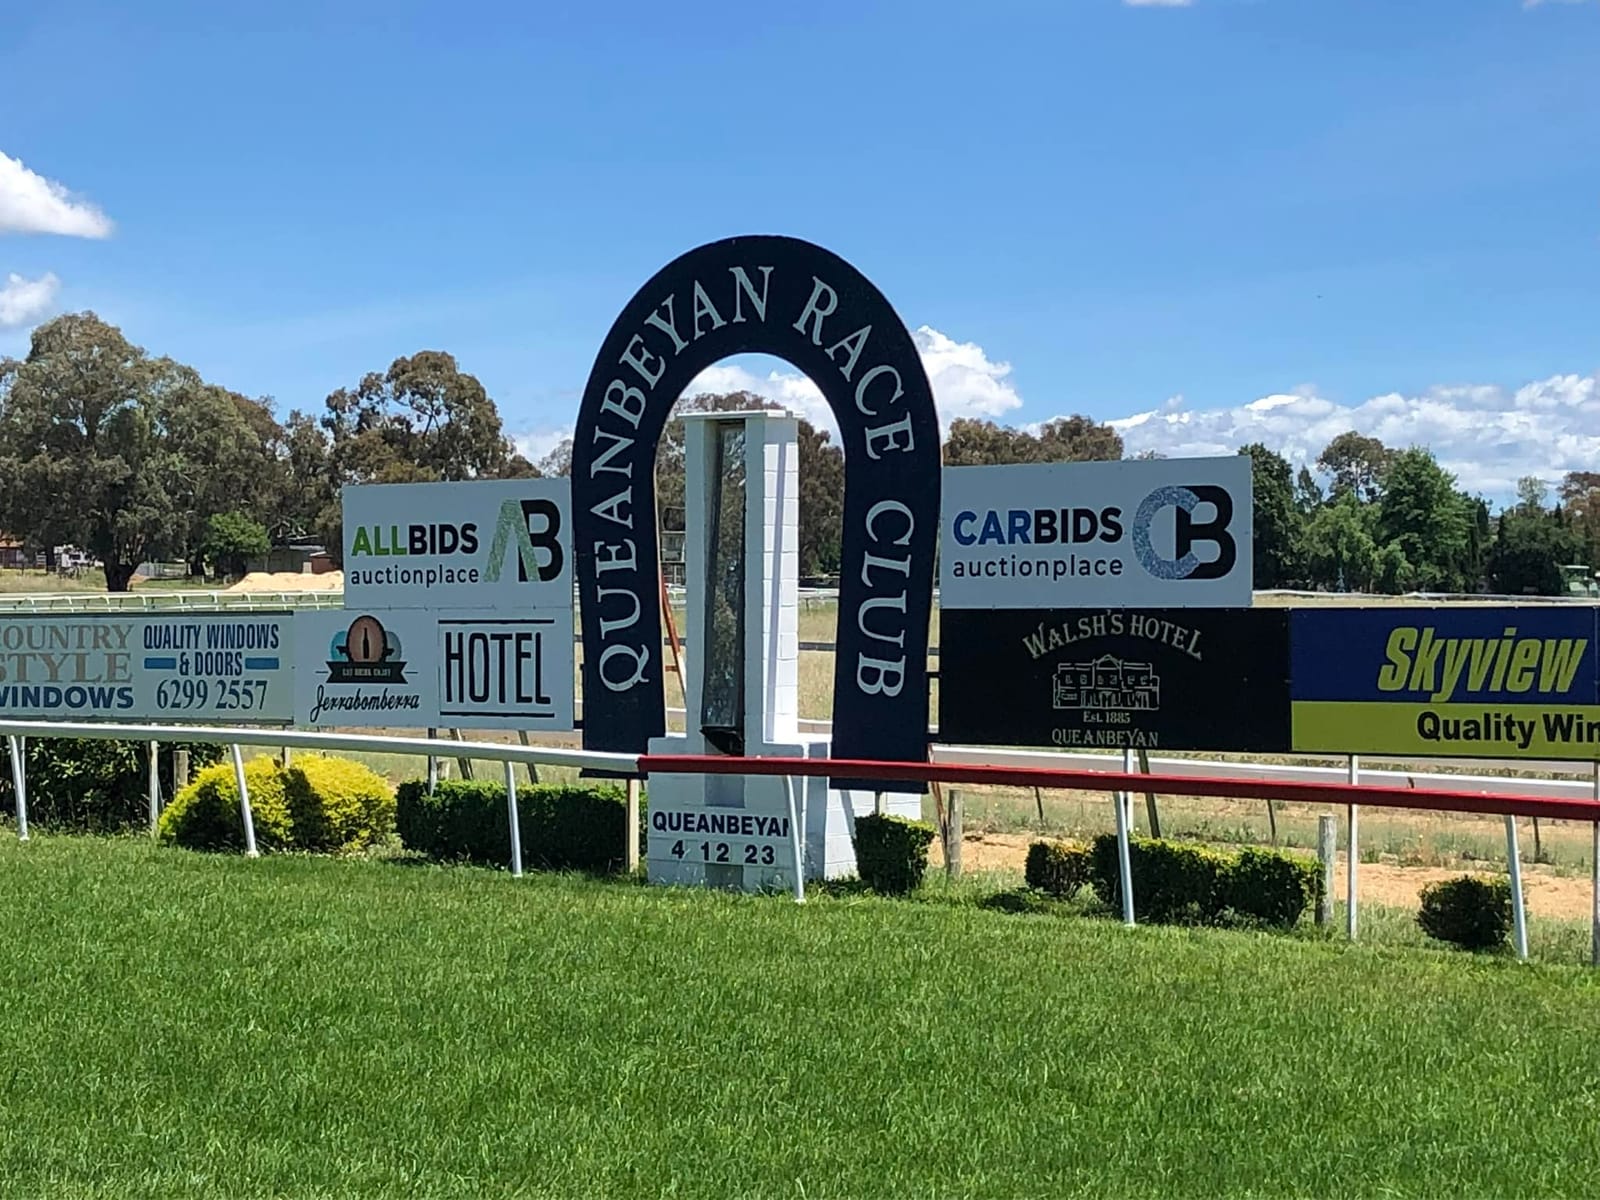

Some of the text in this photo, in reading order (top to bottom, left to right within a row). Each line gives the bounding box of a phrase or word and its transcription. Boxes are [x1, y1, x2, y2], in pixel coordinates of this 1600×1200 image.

[590, 266, 915, 698] QUEANBEYAN RACE CLUB
[351, 523, 479, 556] ALLBIDS
[953, 507, 1123, 546] CARBIDS
[351, 564, 479, 588] auctionplace
[953, 554, 1123, 581] auctionplace
[0, 624, 135, 650] OUNTRY
[143, 623, 280, 650] QUALITY WINDOWS
[1023, 609, 1204, 661] WALSH'S HOTEL
[0, 652, 133, 683] TYLE
[179, 652, 243, 676] & DOORS
[445, 631, 551, 705] HOTEL
[1377, 627, 1588, 703] Skyview
[156, 680, 268, 710] 6299 2557
[309, 684, 420, 723] Jerrabomberra
[1106, 711, 1131, 724] 1885
[1417, 711, 1536, 749] Quality
[1051, 727, 1158, 747] QUEANBEYAN
[671, 840, 775, 864] 4 12 23
